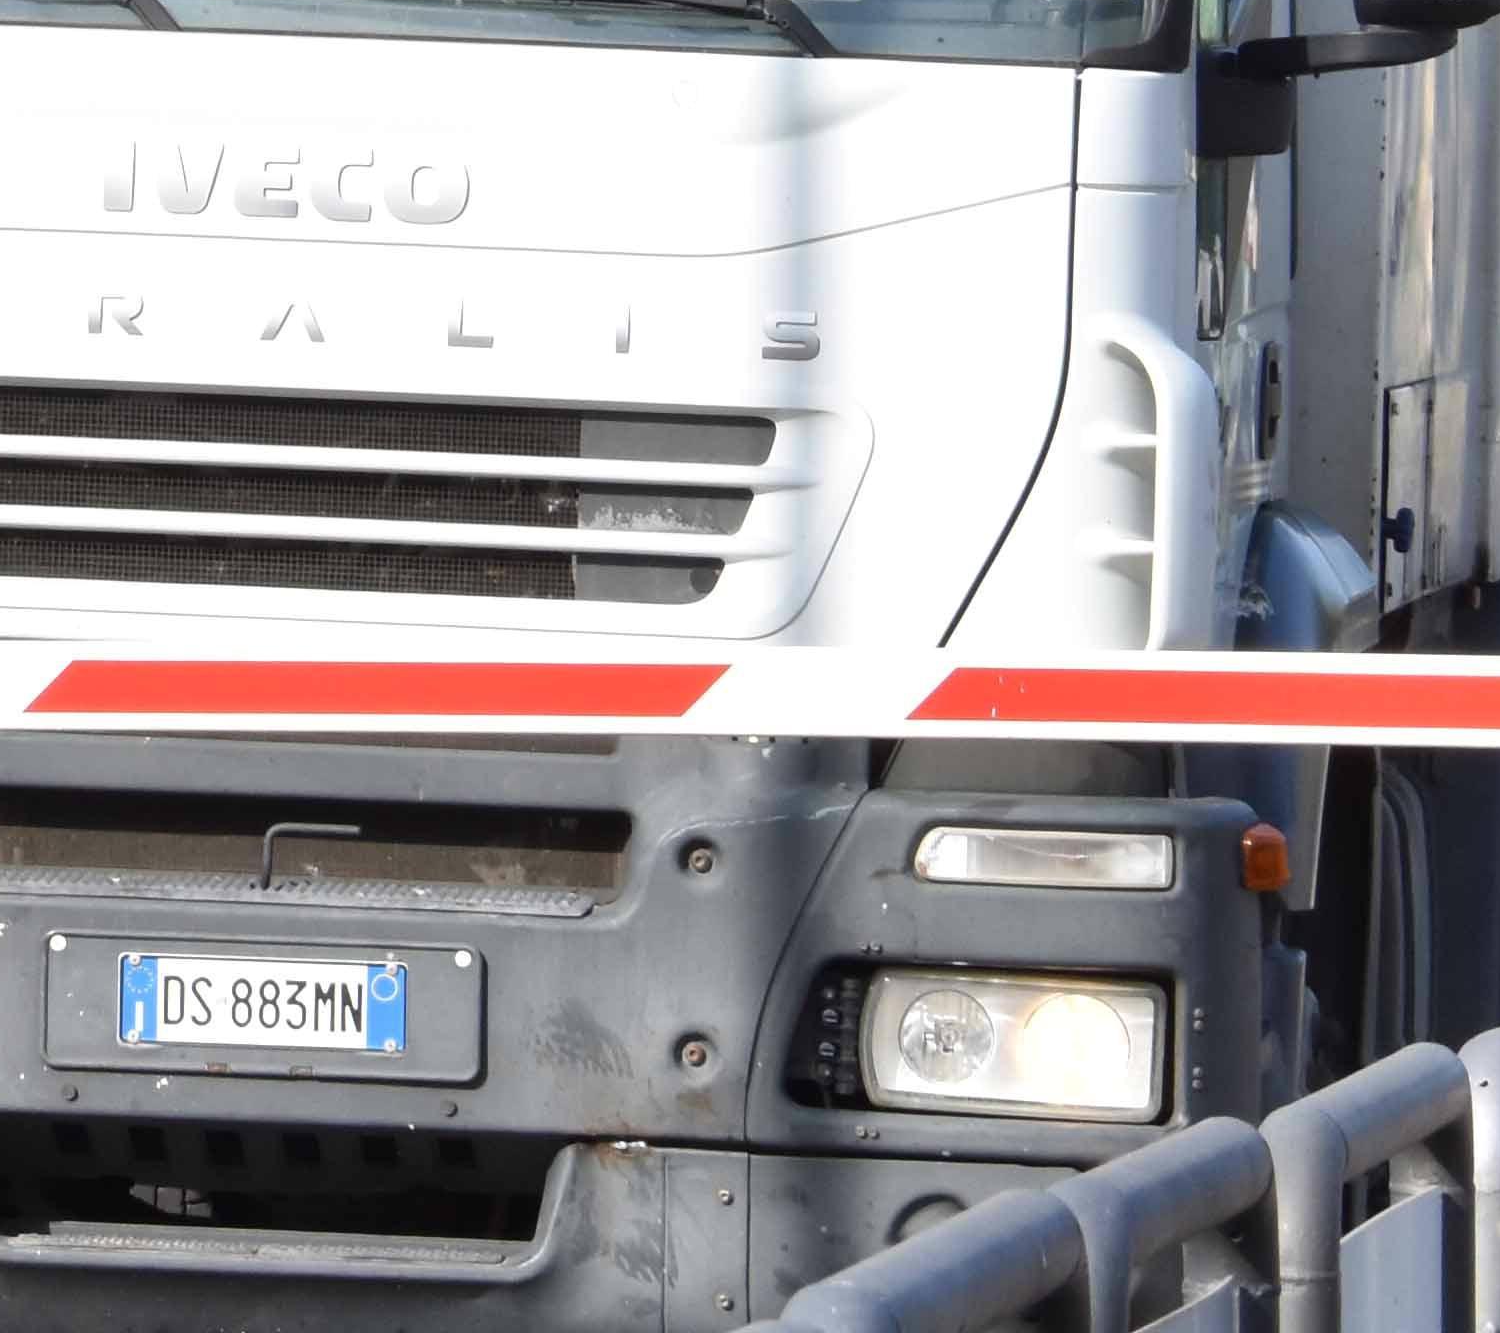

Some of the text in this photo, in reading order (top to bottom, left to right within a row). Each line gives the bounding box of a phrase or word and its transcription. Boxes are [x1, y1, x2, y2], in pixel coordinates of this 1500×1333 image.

[103, 139, 470, 225] IVECO
[163, 975, 363, 1033] DS 883MN
